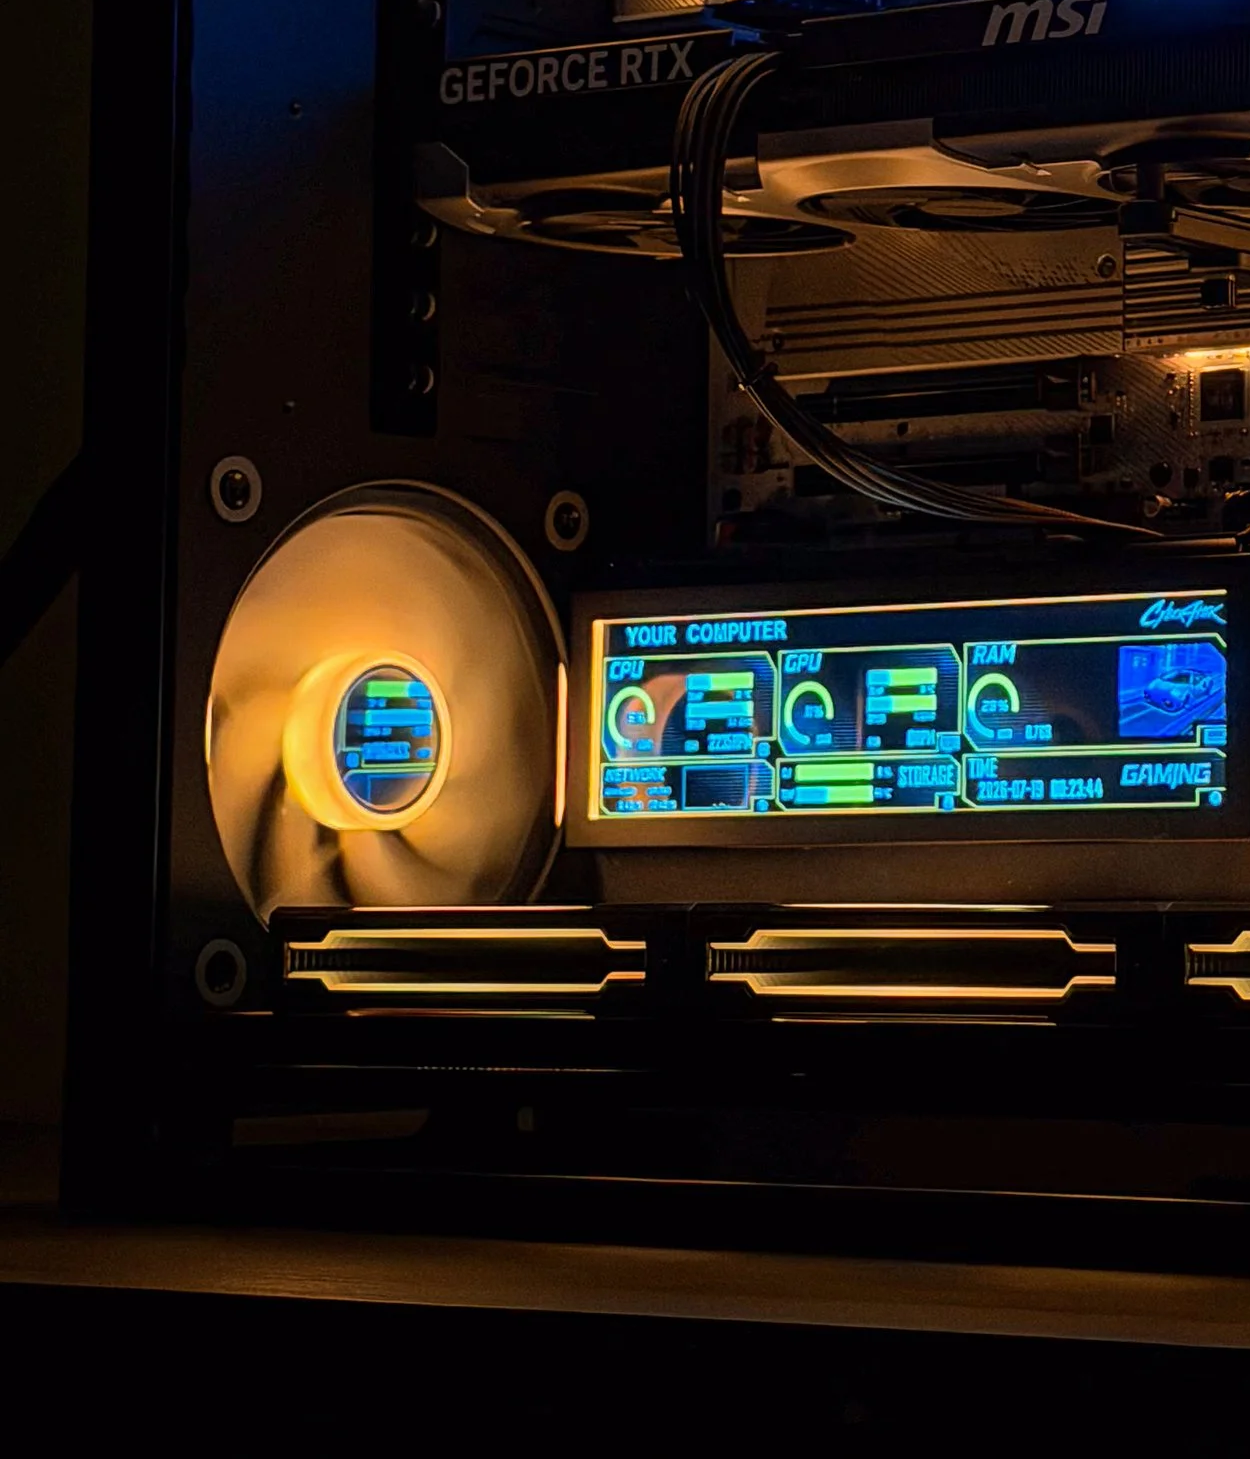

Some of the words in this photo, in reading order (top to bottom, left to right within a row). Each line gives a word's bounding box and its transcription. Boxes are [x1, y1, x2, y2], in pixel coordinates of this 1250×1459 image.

[439, 50, 609, 105] GEFORCE
[620, 40, 695, 85] RTX
[625, 624, 677, 647] YOUR
[686, 619, 788, 644] COMPUTER
[784, 652, 823, 673] GPU
[972, 644, 1017, 665] RAM
[608, 659, 645, 681] CPU
[604, 767, 667, 784] NETWORK
[897, 764, 956, 788] STORAGE
[967, 757, 998, 779] TIME
[1120, 762, 1211, 789] GAMING
